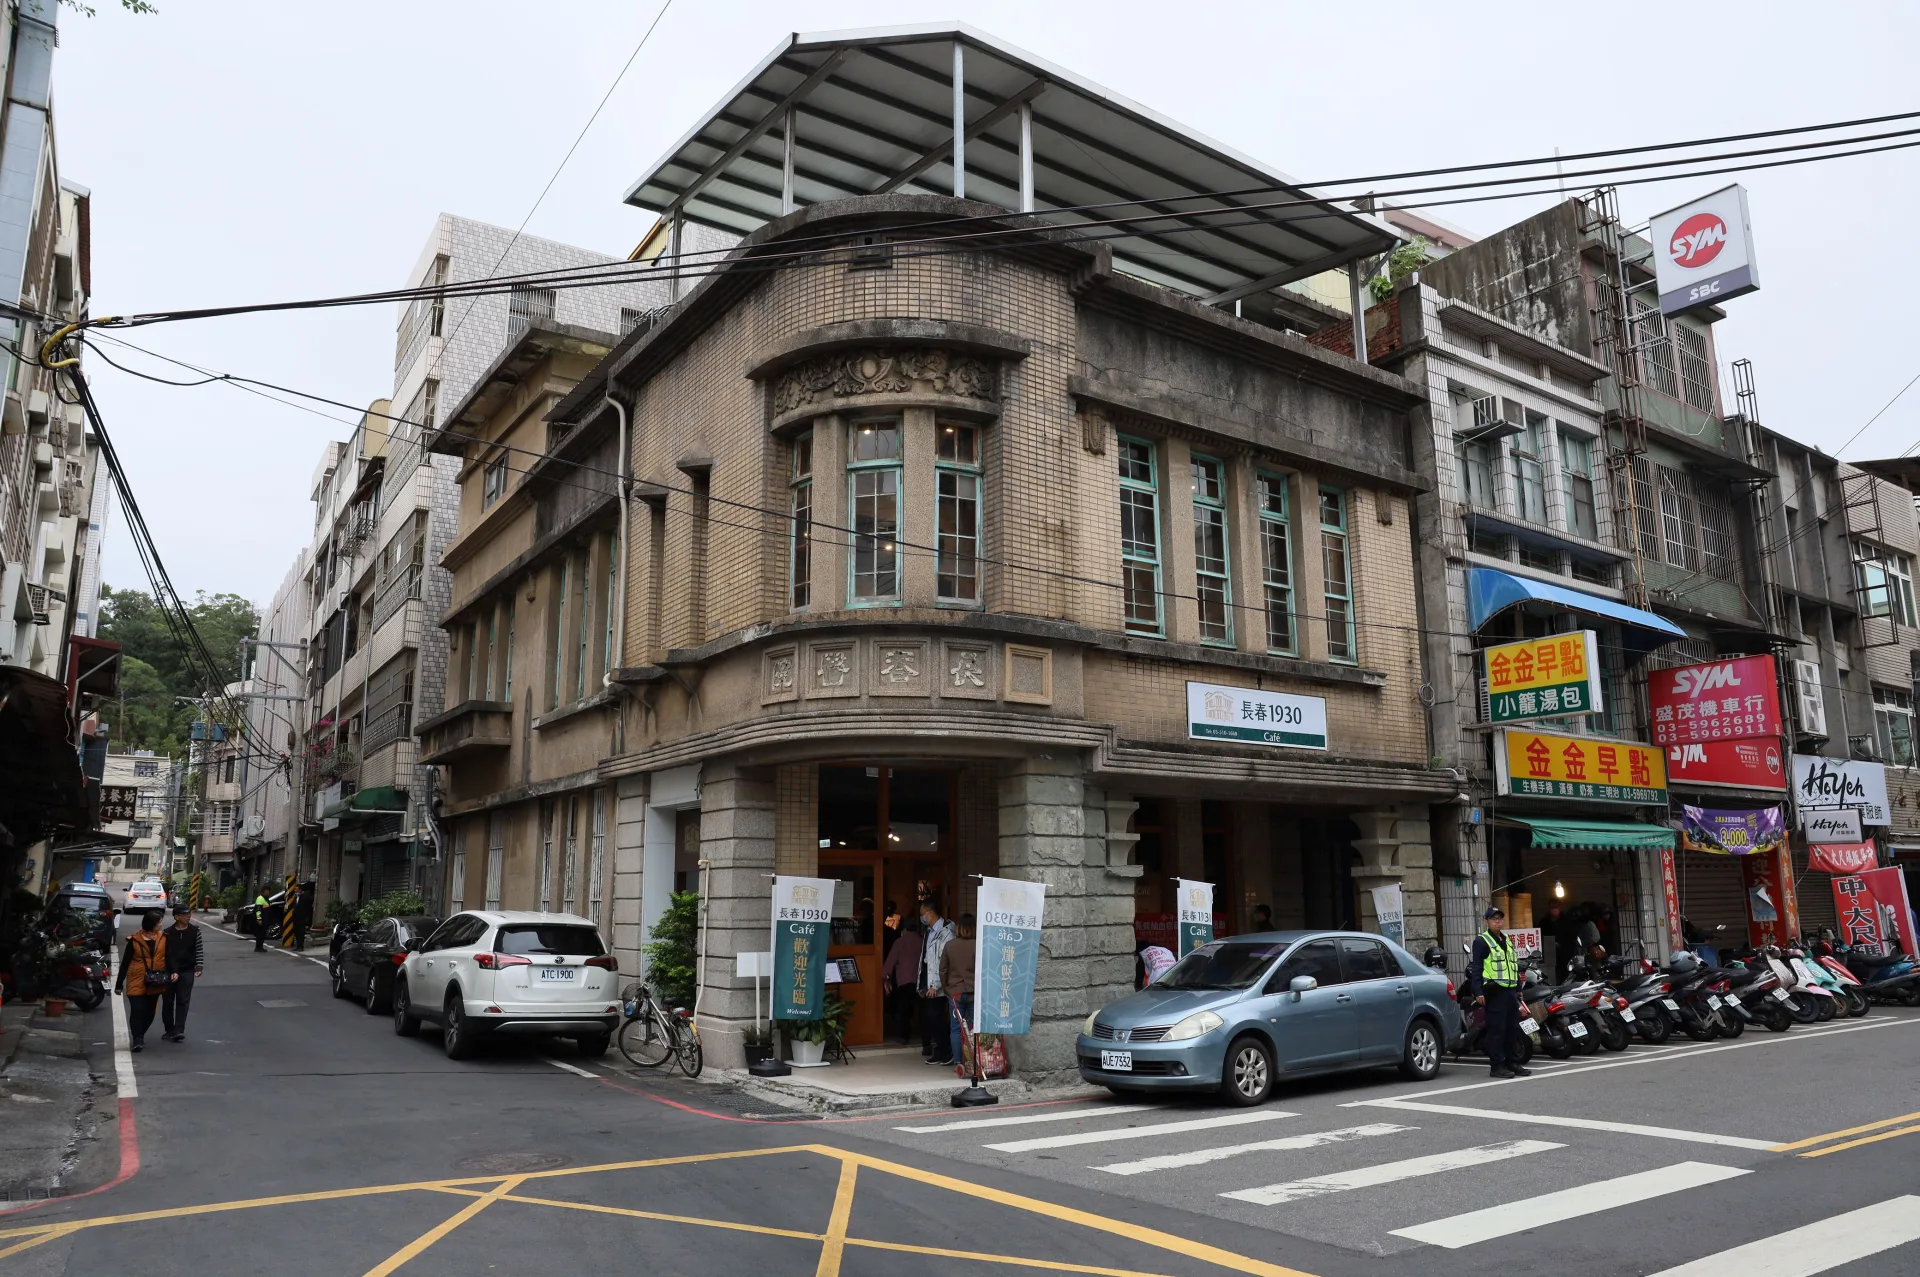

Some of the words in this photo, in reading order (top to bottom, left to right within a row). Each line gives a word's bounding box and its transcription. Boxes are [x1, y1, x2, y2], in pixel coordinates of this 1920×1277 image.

[1670, 223, 1727, 261] SYM
[1689, 280, 1720, 301] SBC
[1491, 639, 1583, 687] 金金早點
[1672, 664, 1741, 698] SYM
[1241, 700, 1302, 725] 長春1930
[1498, 686, 1582, 717] 小籠湯包
[1656, 694, 1764, 722] 盛茂機車行
[1657, 713, 1765, 733] 03-5962689
[1658, 724, 1766, 743] 03-5969911
[1263, 731, 1281, 742] Café
[1526, 737, 1651, 786] 金金早點
[1522, 779, 1553, 795] 生機手捲
[1559, 782, 1574, 796] 漢堡
[1579, 785, 1594, 797] 奶茶
[1599, 786, 1620, 799] 三明治
[1622, 788, 1659, 802] 03-5969792
[780, 907, 828, 921] 長春1930
[1181, 909, 1212, 922] 長春13
[789, 923, 815, 935] Café
[792, 938, 810, 1005] 歡迎光臨
